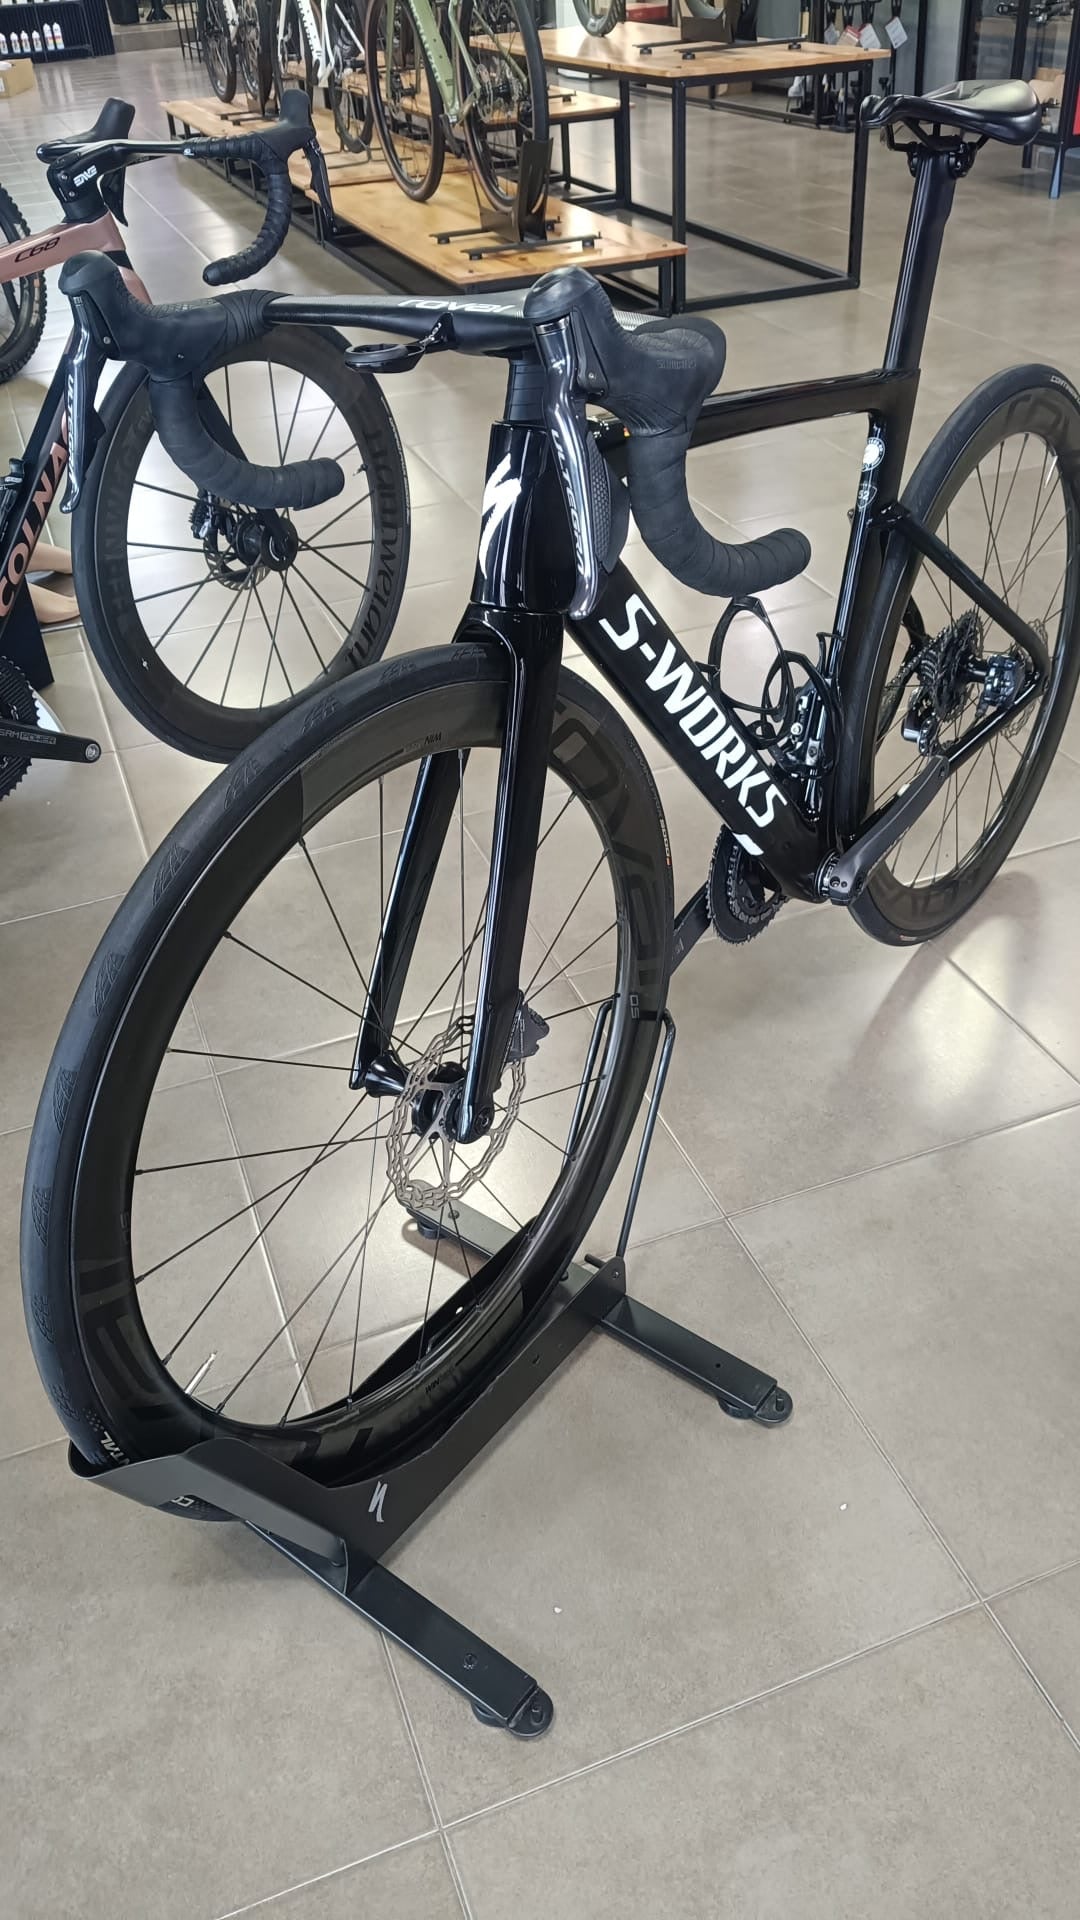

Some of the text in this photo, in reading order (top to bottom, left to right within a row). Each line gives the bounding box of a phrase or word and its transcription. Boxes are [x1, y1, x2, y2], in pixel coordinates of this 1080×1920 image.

[14, 236, 61, 263] C68
[551, 428, 586, 576] ULTEGRA
[598, 593, 788, 828] S-WORKS
